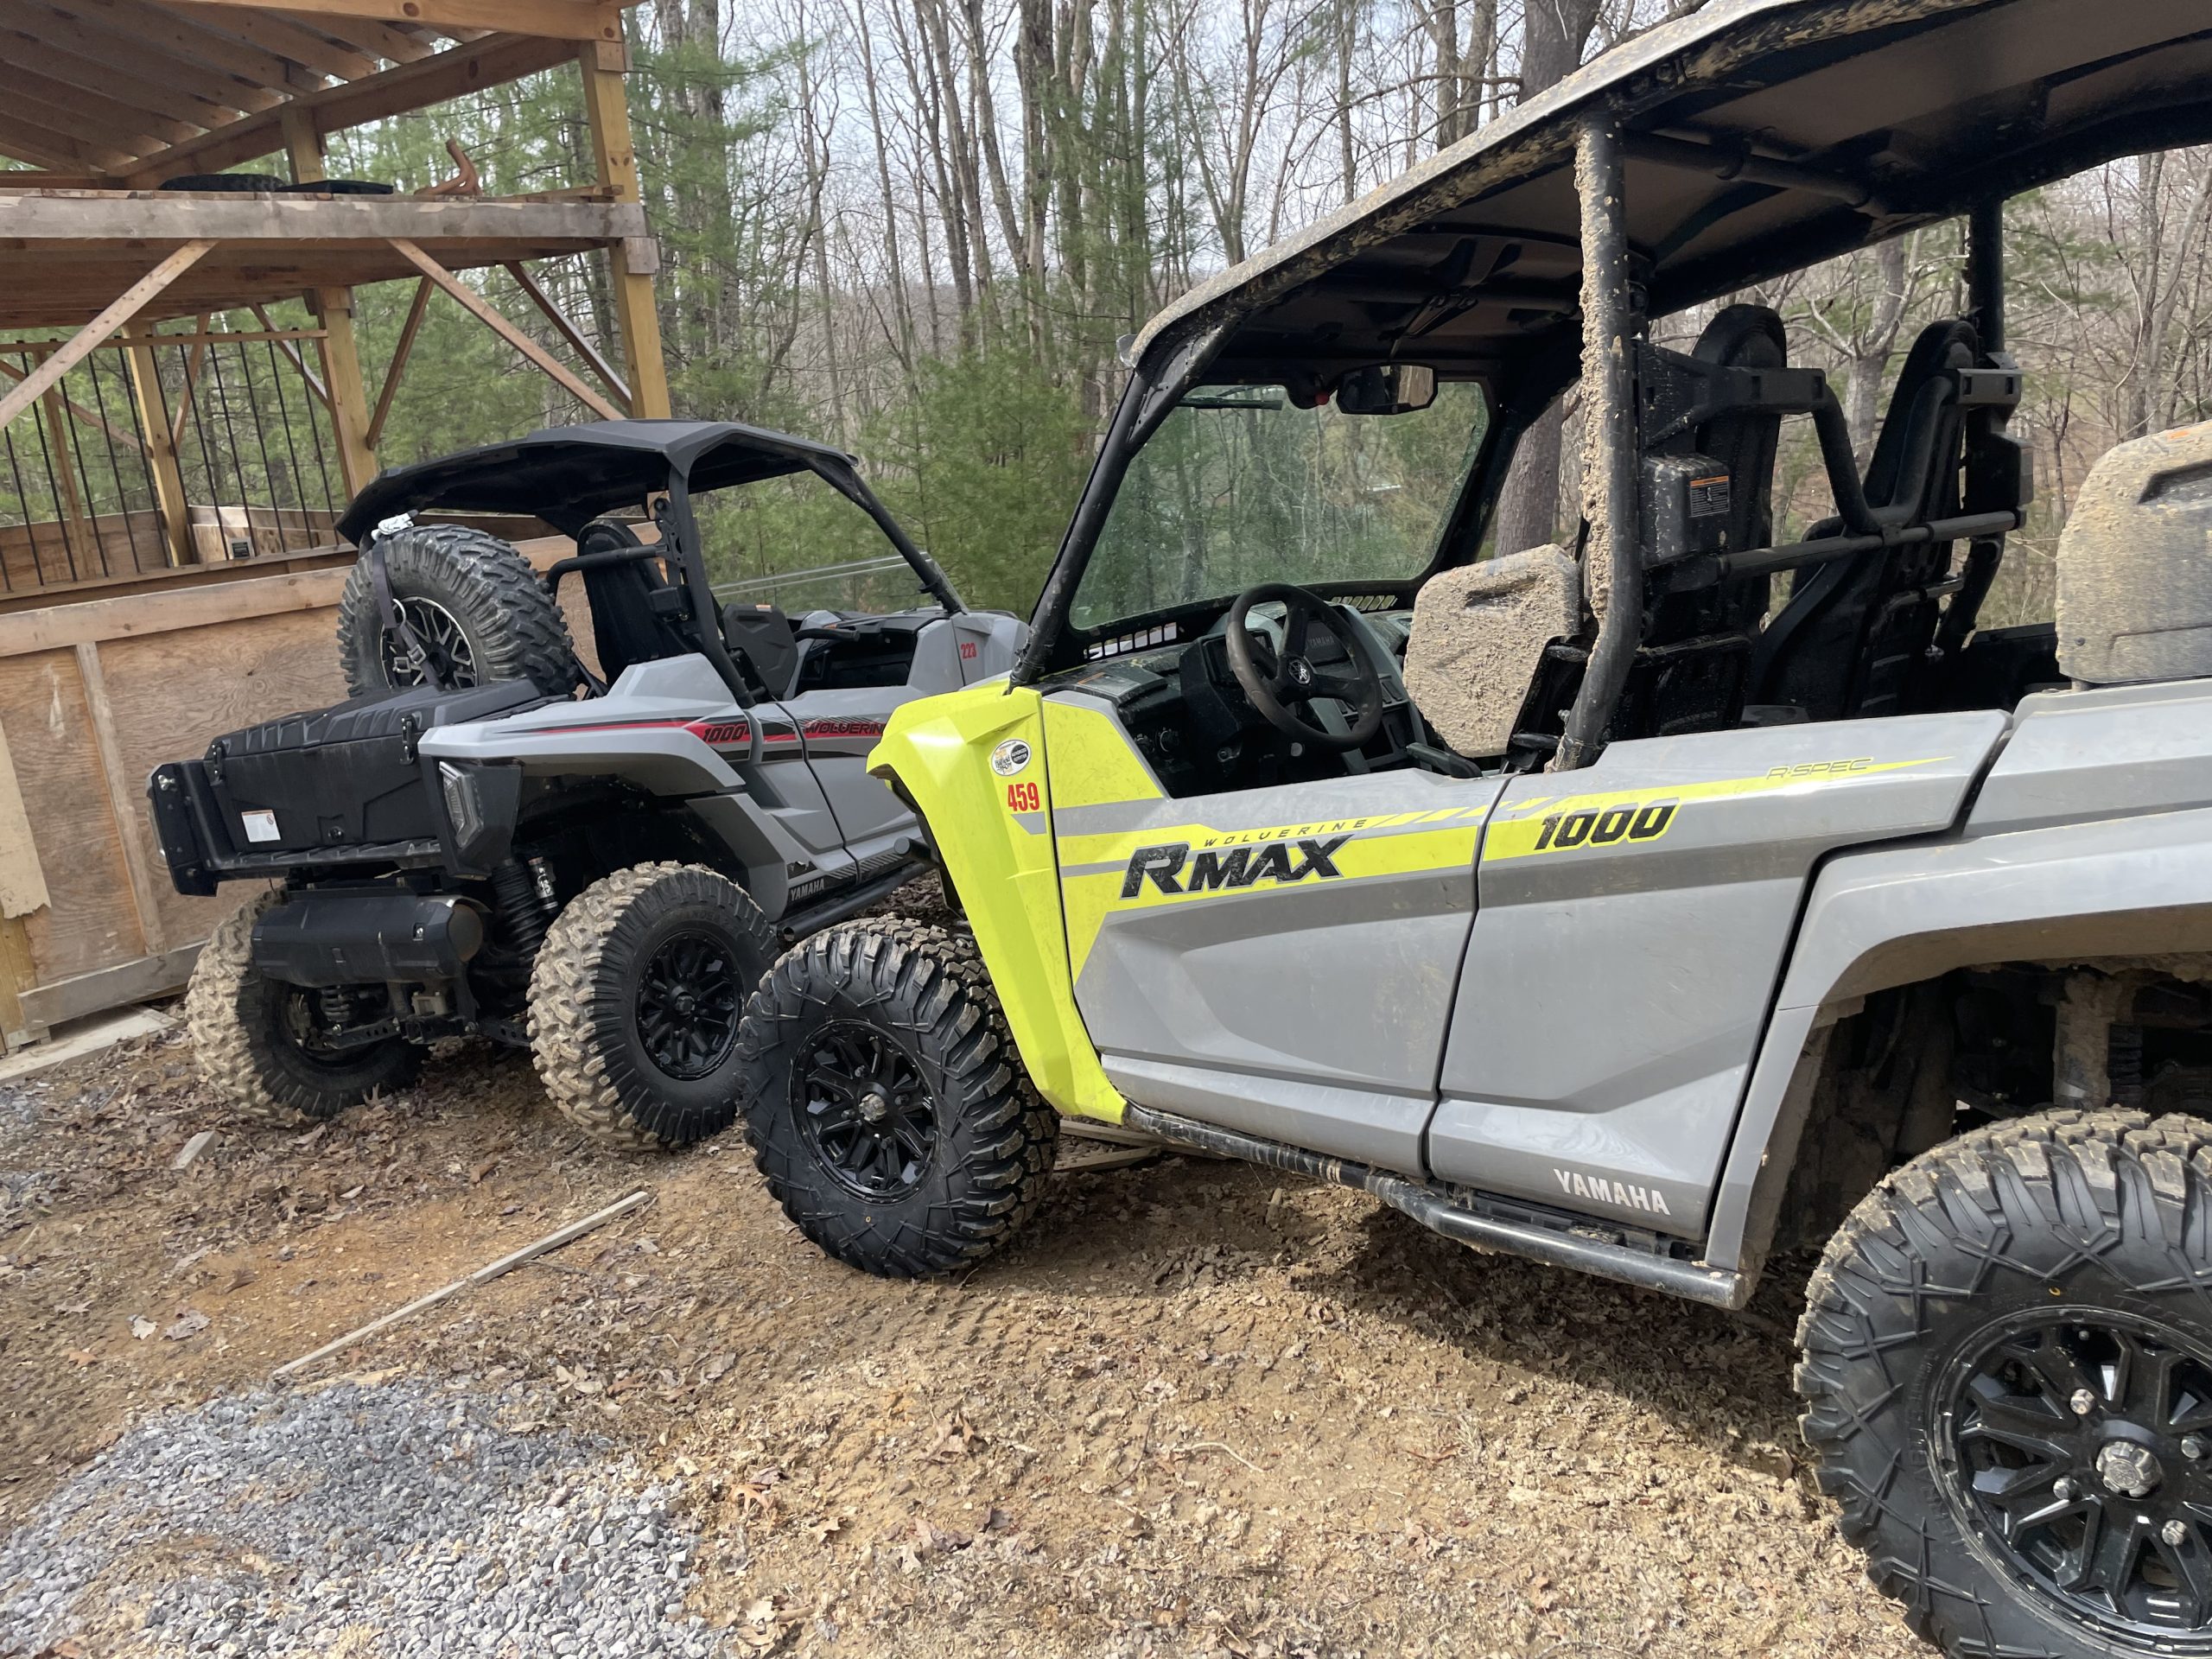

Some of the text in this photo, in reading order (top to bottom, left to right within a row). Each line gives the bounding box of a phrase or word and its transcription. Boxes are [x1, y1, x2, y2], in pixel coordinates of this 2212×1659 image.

[961, 643, 976, 659] 223
[702, 724, 747, 742] 1000
[804, 722, 886, 734] WOLVERIN
[1007, 782, 1039, 811] 459
[1204, 818, 1368, 848] WOLVERINE
[1534, 798, 1679, 850] 1000
[1120, 834, 1355, 899] RMAX
[791, 877, 824, 901] YAMAHA
[1554, 1168, 1671, 1216] YAMAHA
